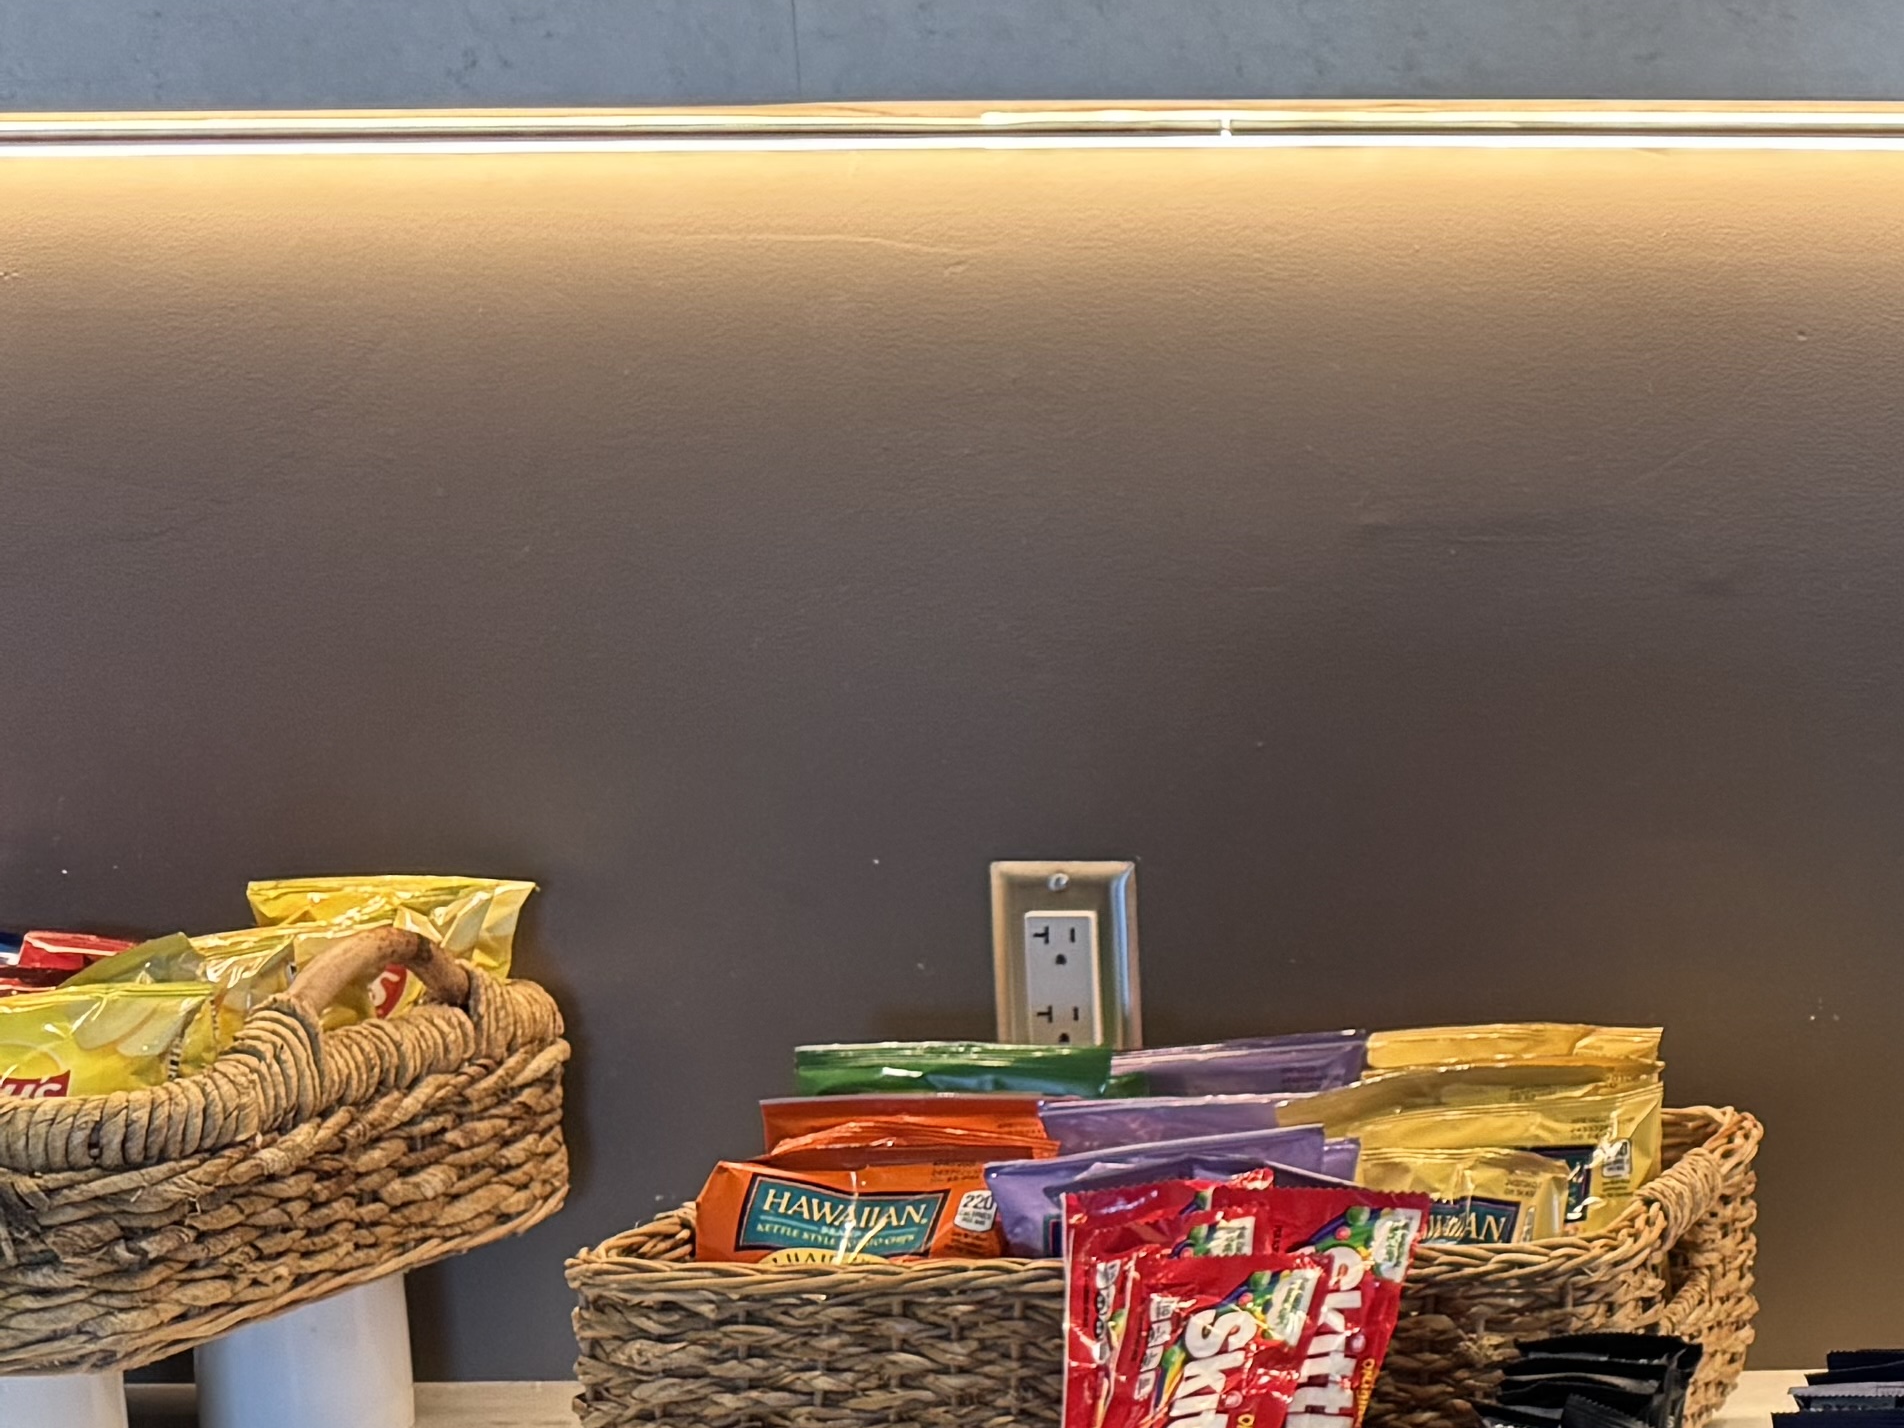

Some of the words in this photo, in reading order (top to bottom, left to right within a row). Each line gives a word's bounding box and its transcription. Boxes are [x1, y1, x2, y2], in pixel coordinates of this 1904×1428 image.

[763, 1188, 927, 1230] HAWAIIAN
[962, 1194, 993, 1210] 220
[756, 1224, 799, 1237] KETTLE
[801, 1232, 836, 1246] STYLE
